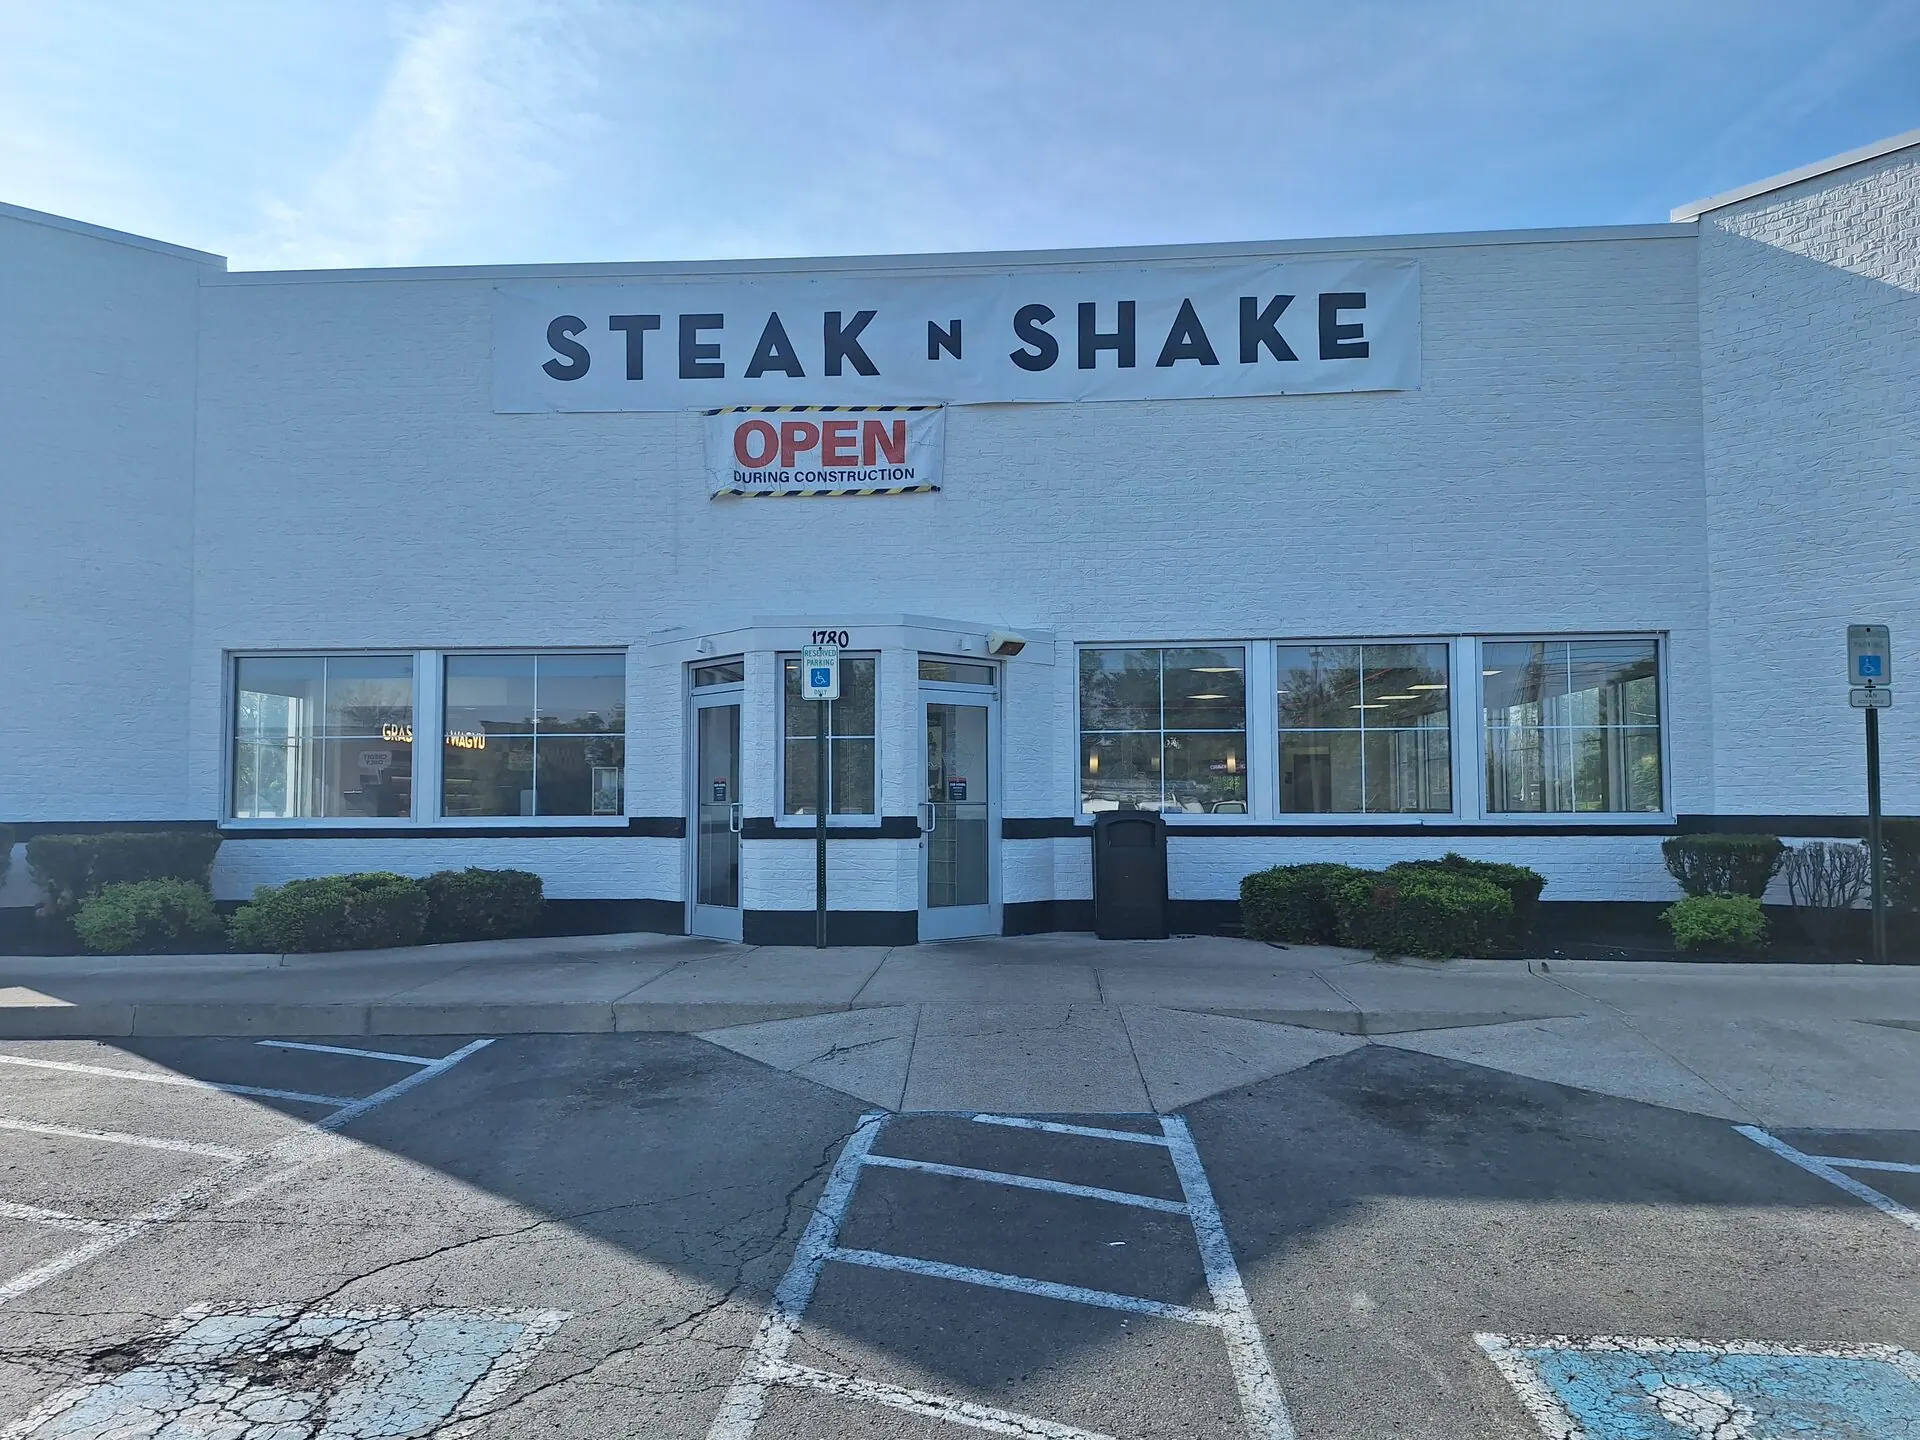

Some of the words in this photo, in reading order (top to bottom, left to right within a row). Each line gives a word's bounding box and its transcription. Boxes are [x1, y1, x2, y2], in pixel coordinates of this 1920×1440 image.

[542, 310, 881, 381] STEAK
[928, 319, 962, 361] N
[1009, 292, 1369, 371] SHAKE
[734, 420, 906, 468] OPEN
[734, 470, 789, 484] DURING
[794, 468, 915, 483] CONSTRUCTION
[812, 630, 849, 648] 1780
[804, 649, 836, 657] RESERVED
[383, 723, 413, 743] GRAS
